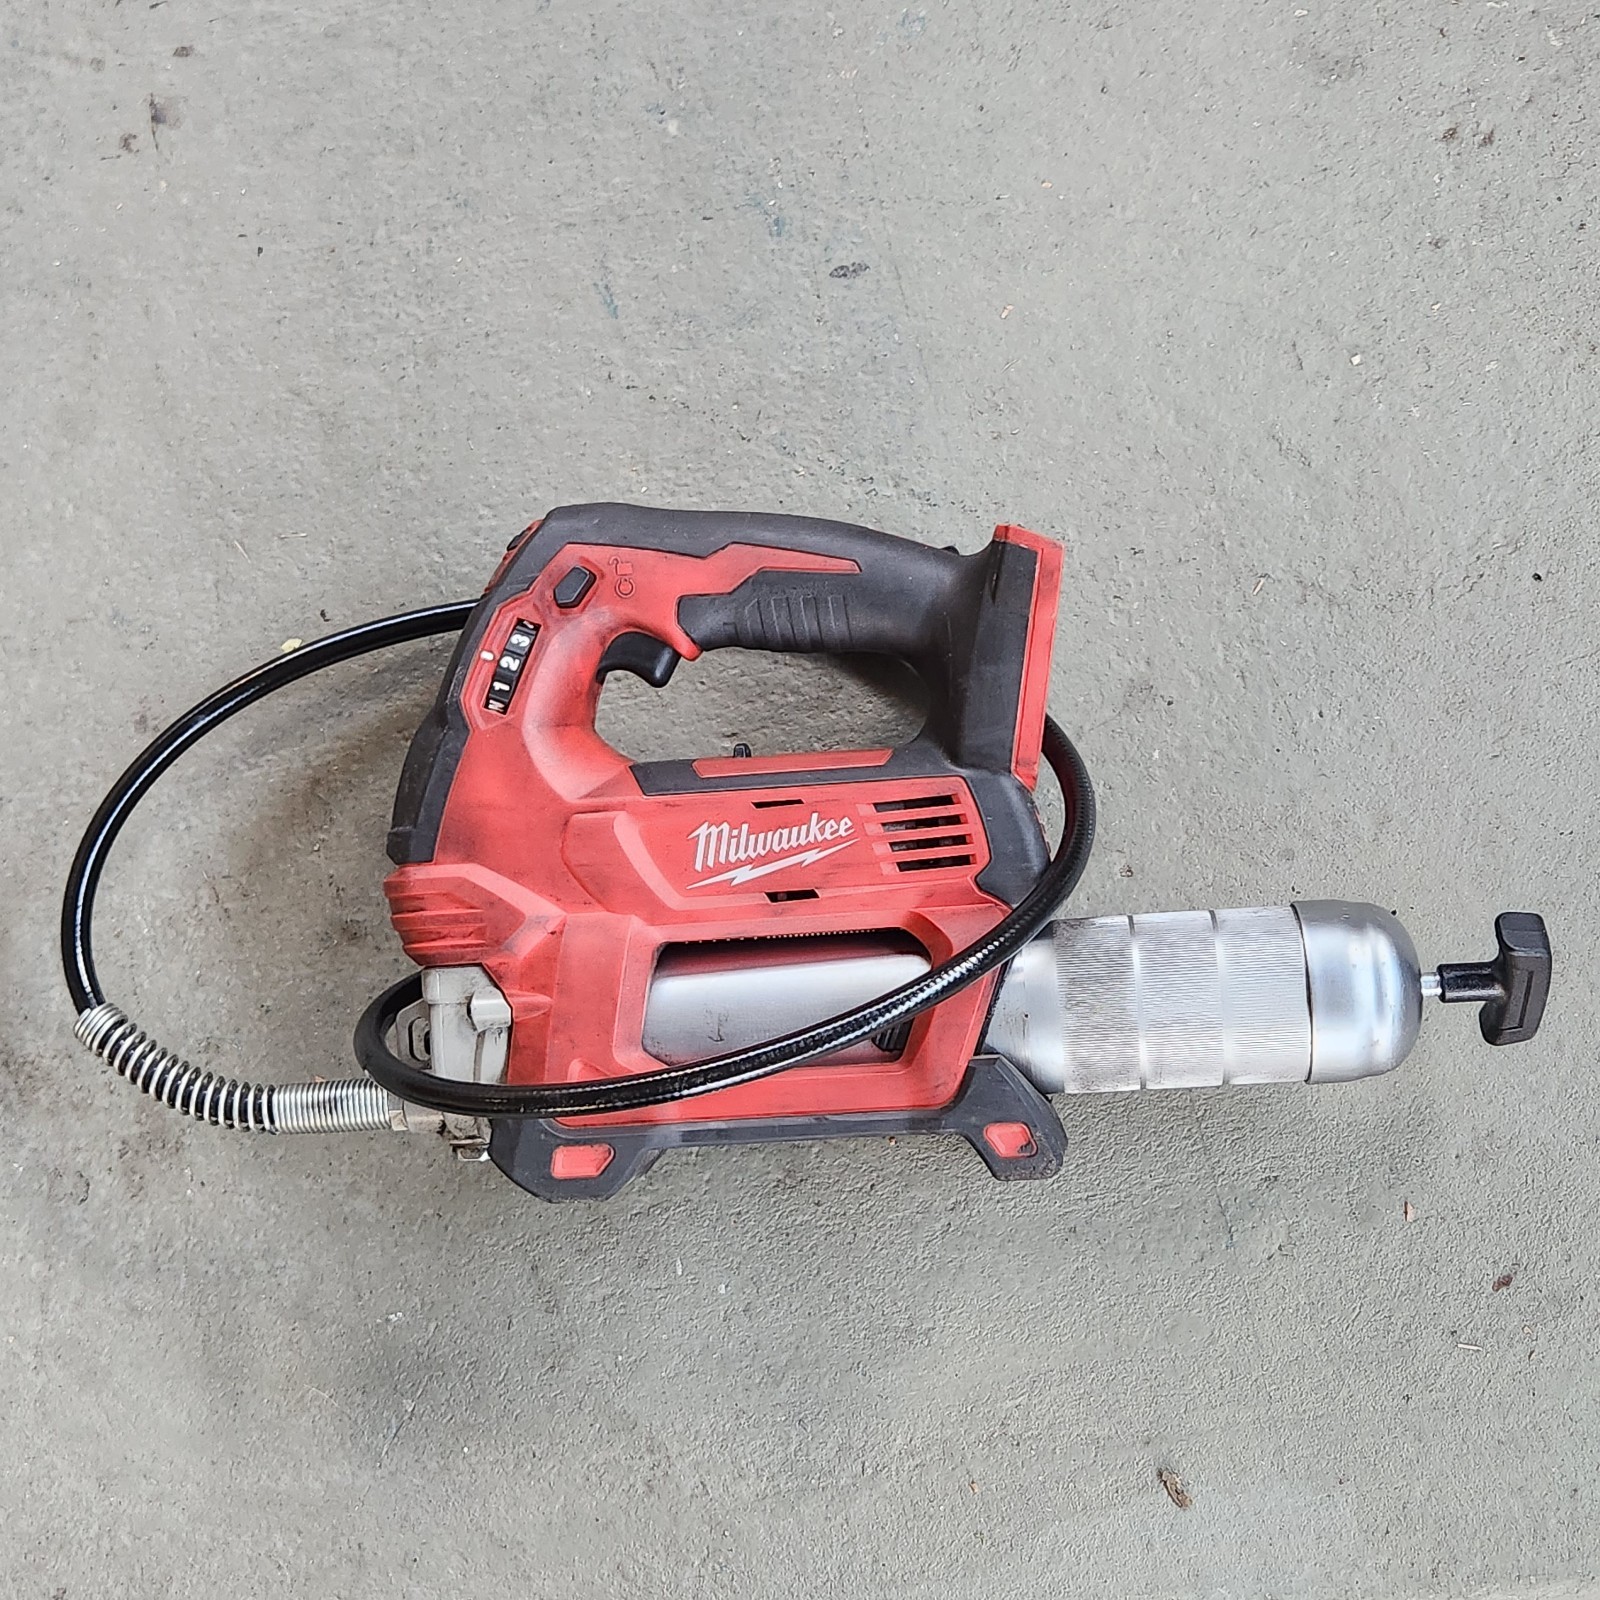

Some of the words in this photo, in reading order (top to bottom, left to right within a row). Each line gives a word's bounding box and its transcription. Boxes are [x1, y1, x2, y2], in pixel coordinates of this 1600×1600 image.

[510, 633, 530, 647] 3
[500, 656, 520, 671] 2
[493, 681, 510, 691] 1
[687, 812, 855, 872] Milwaukee
